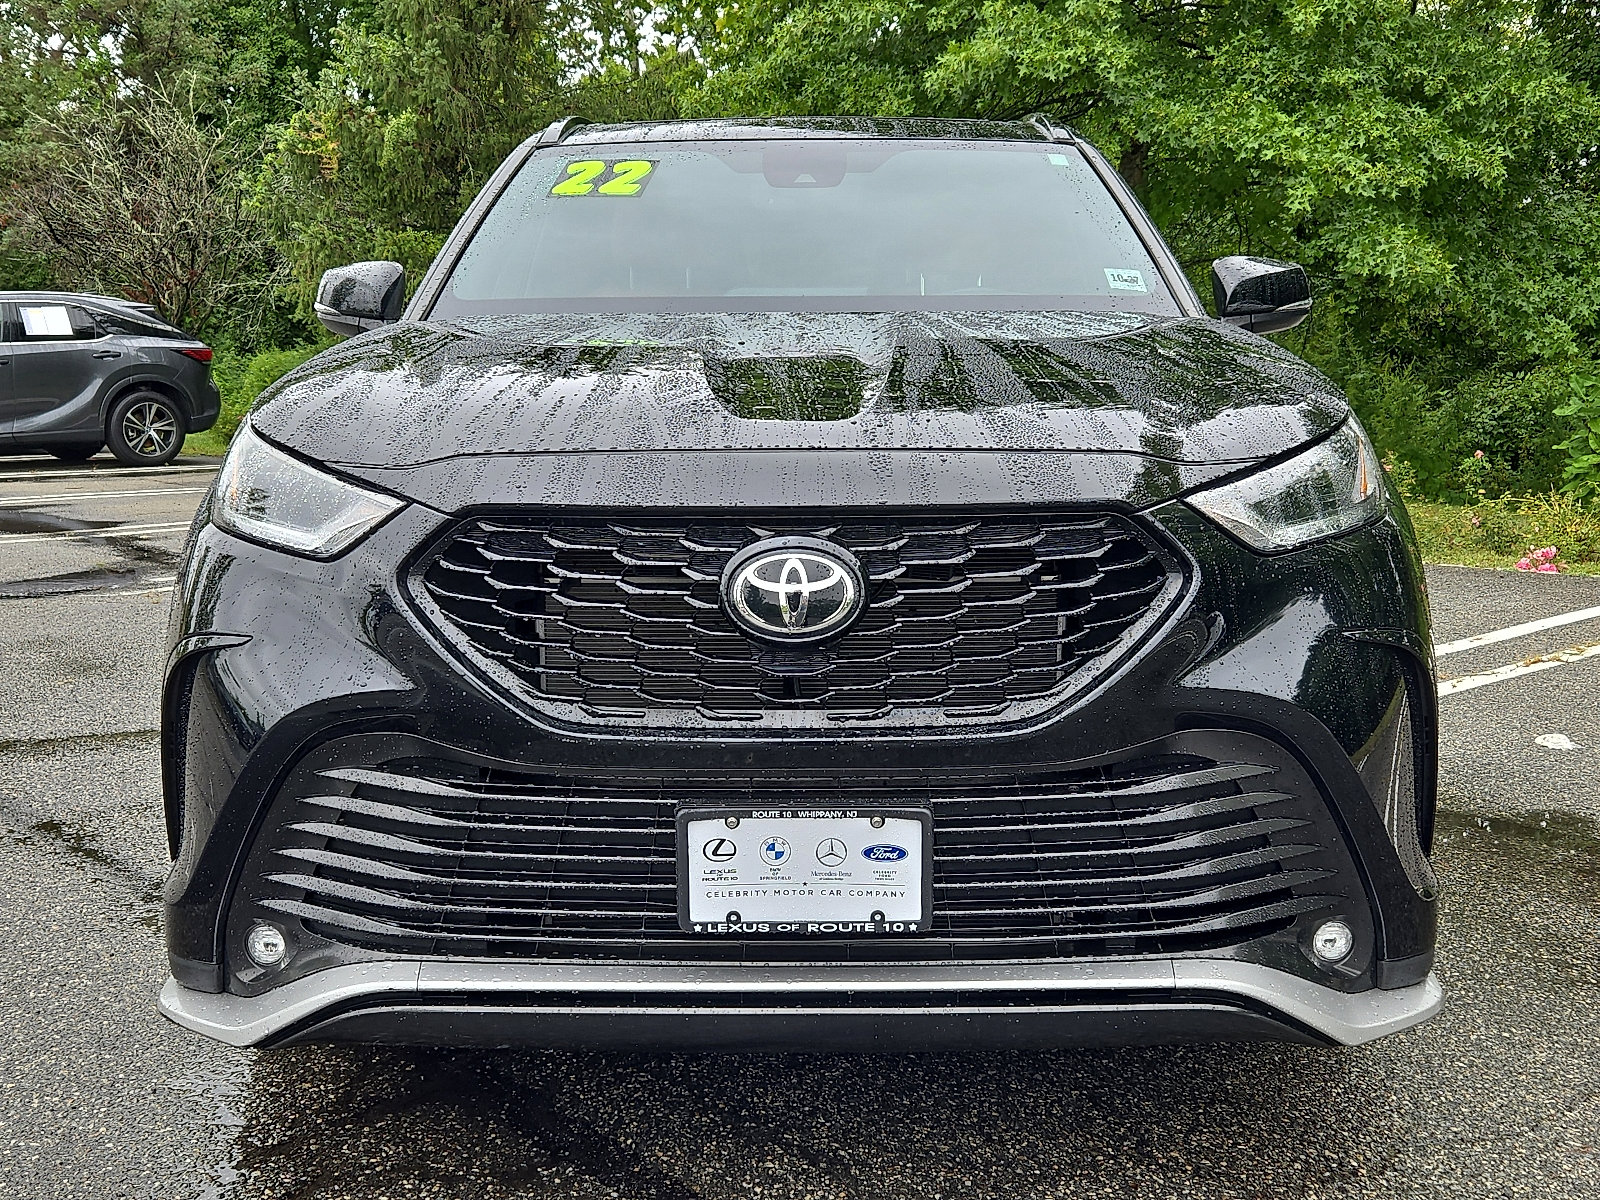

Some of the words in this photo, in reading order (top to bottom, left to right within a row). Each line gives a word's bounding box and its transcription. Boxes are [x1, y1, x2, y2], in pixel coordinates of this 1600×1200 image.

[551, 160, 653, 196] 22
[846, 810, 858, 818] NJ
[870, 846, 899, 859] Ford
[706, 889, 768, 899] CELEBRITY
[820, 889, 842, 897] CAR
[848, 889, 906, 898] COMPANY
[707, 923, 770, 933] LEXUS
[776, 923, 800, 932] OF
[807, 922, 875, 932] ROUTE
[883, 922, 905, 932] 10
